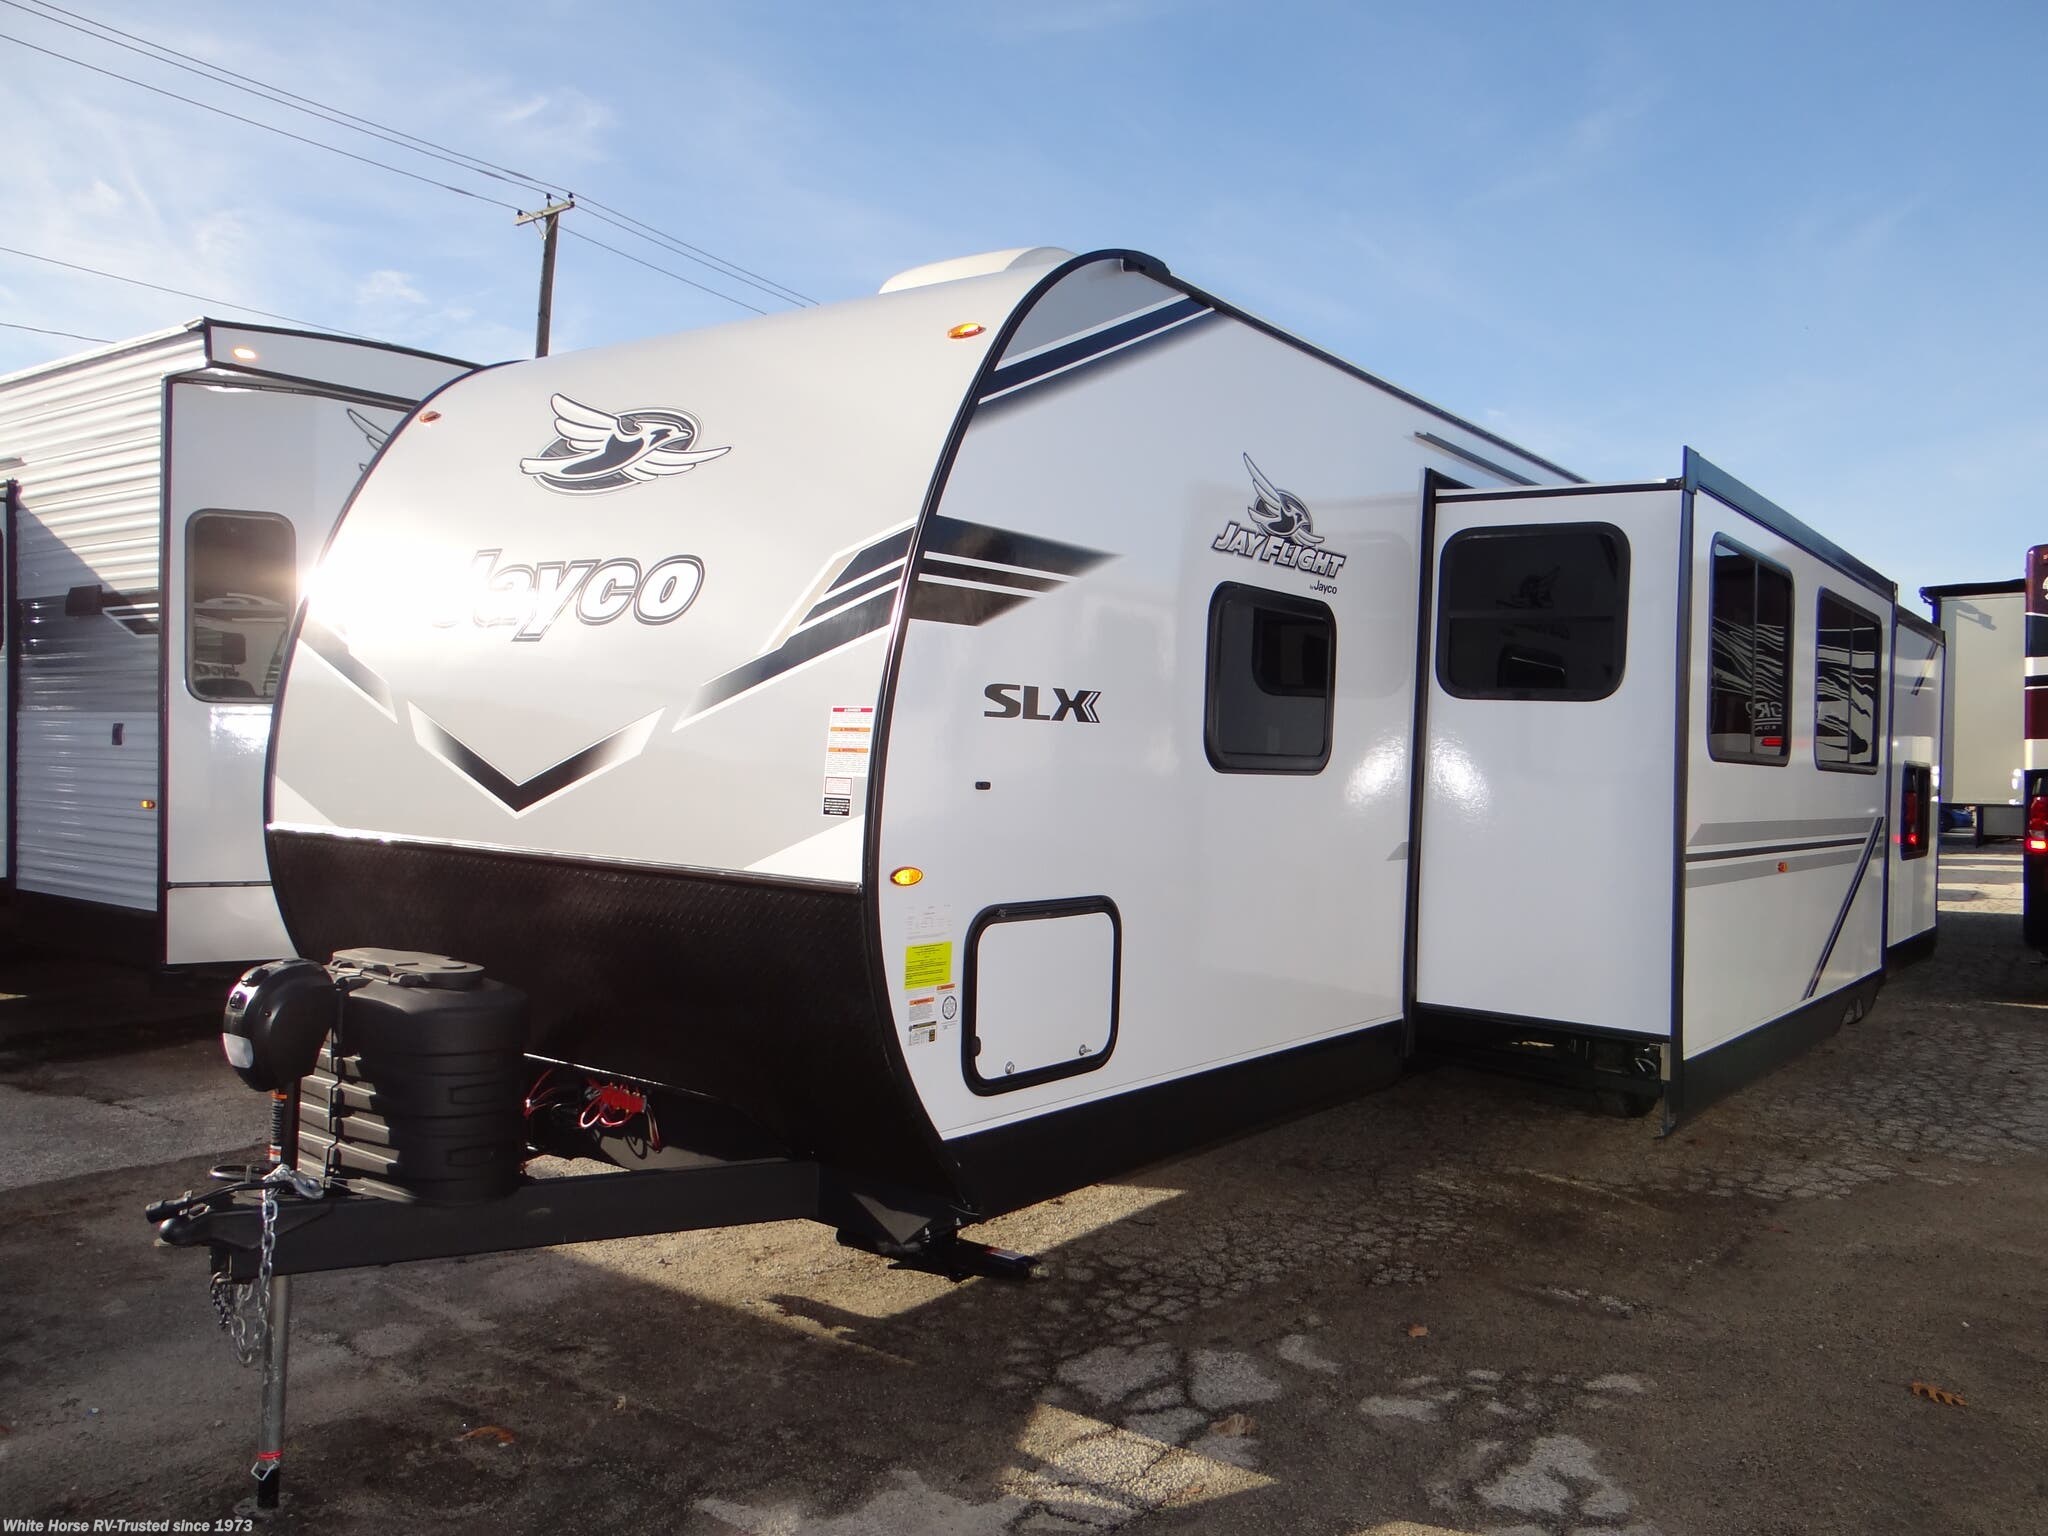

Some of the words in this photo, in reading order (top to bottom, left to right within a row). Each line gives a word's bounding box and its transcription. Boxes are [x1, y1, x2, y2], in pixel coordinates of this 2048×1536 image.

[1212, 521, 1264, 556] JAY
[1261, 535, 1346, 578] FLIGHT
[1314, 580, 1337, 594] Jayco
[984, 683, 1102, 723] SLX
